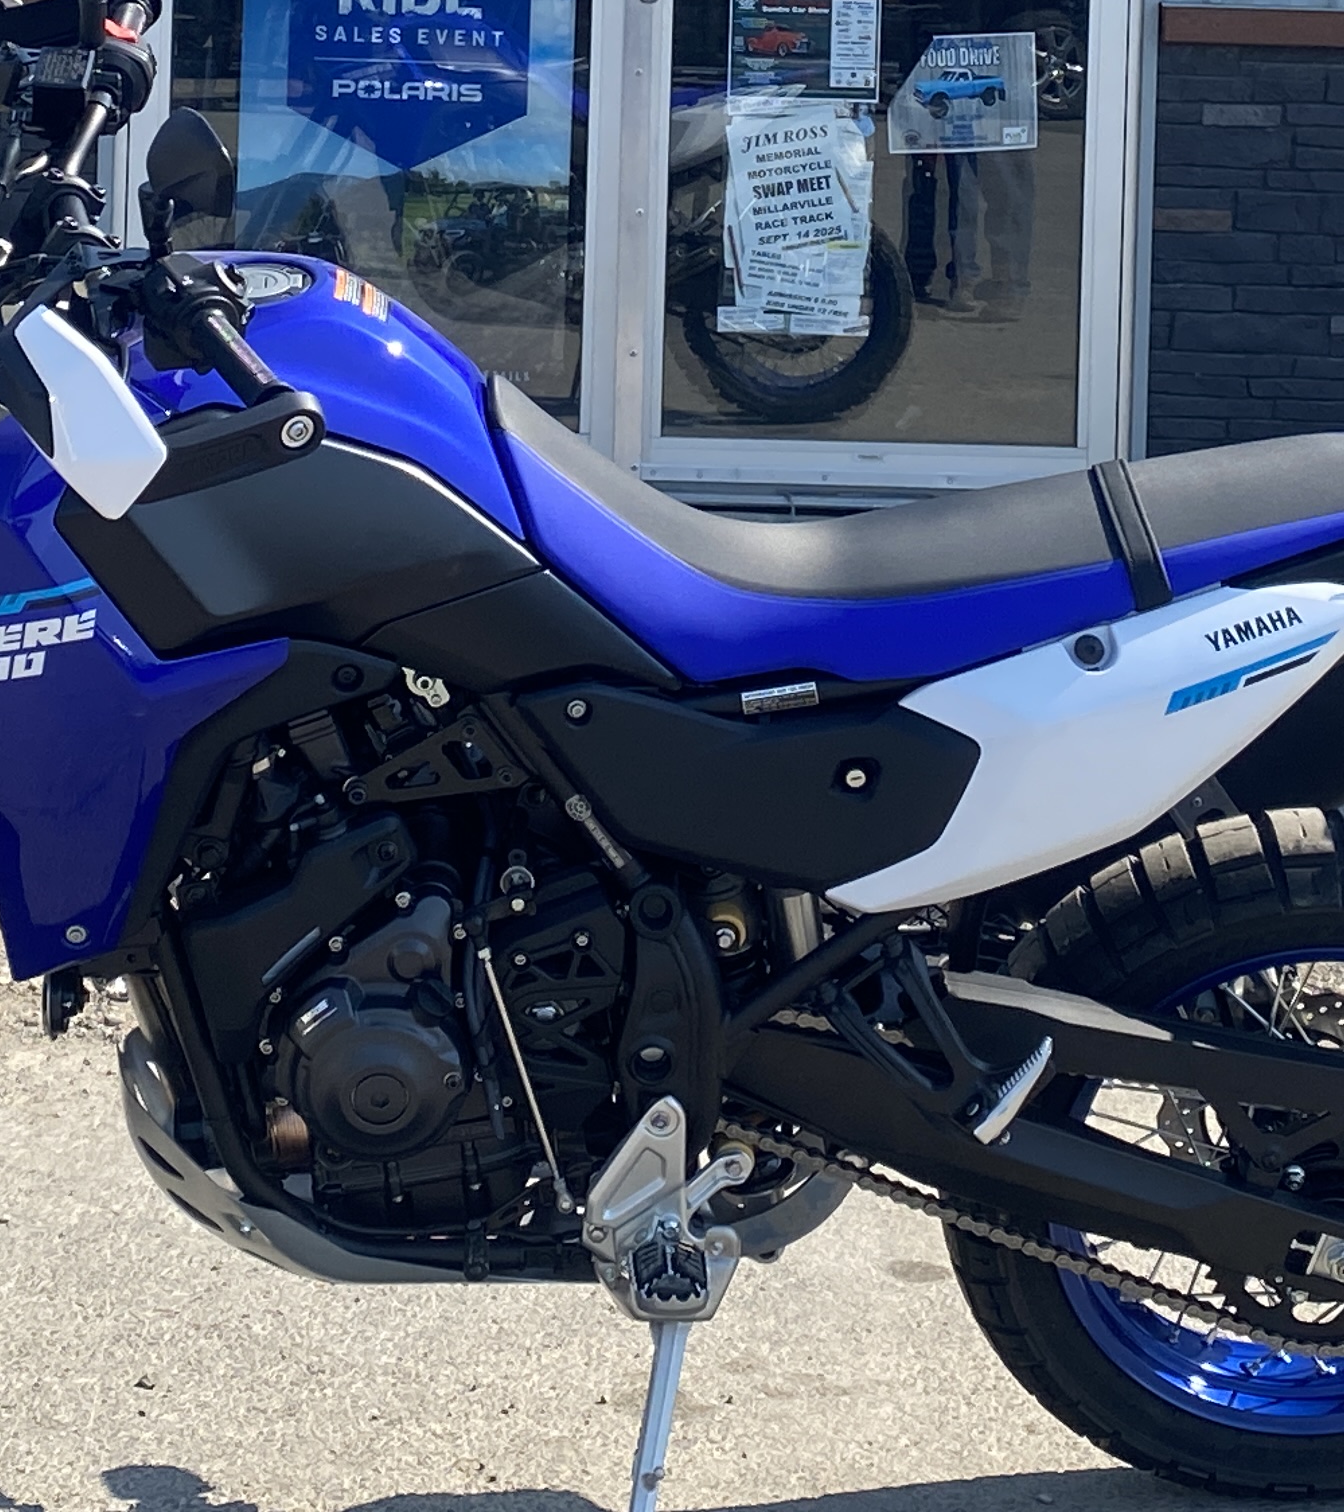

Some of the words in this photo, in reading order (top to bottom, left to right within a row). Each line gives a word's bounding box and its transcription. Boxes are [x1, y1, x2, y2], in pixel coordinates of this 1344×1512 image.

[315, 25, 402, 43] SALES
[417, 28, 504, 47] EVENT
[959, 46, 1001, 67] DRIVE
[331, 79, 483, 102] POLARIS
[741, 130, 779, 154] JIM
[783, 124, 829, 143] ROSS
[756, 146, 822, 164] MEMORIAL
[747, 159, 832, 181] MOTORCYCLE
[752, 181, 794, 199] SWAP
[796, 175, 832, 194] MEET
[752, 196, 834, 217] MILLARVILLE
[755, 217, 788, 231] RACE
[791, 211, 834, 226] TRACK
[796, 230, 810, 239] 14
[812, 225, 842, 237] 2025
[1204, 606, 1303, 652] YAMAHA
